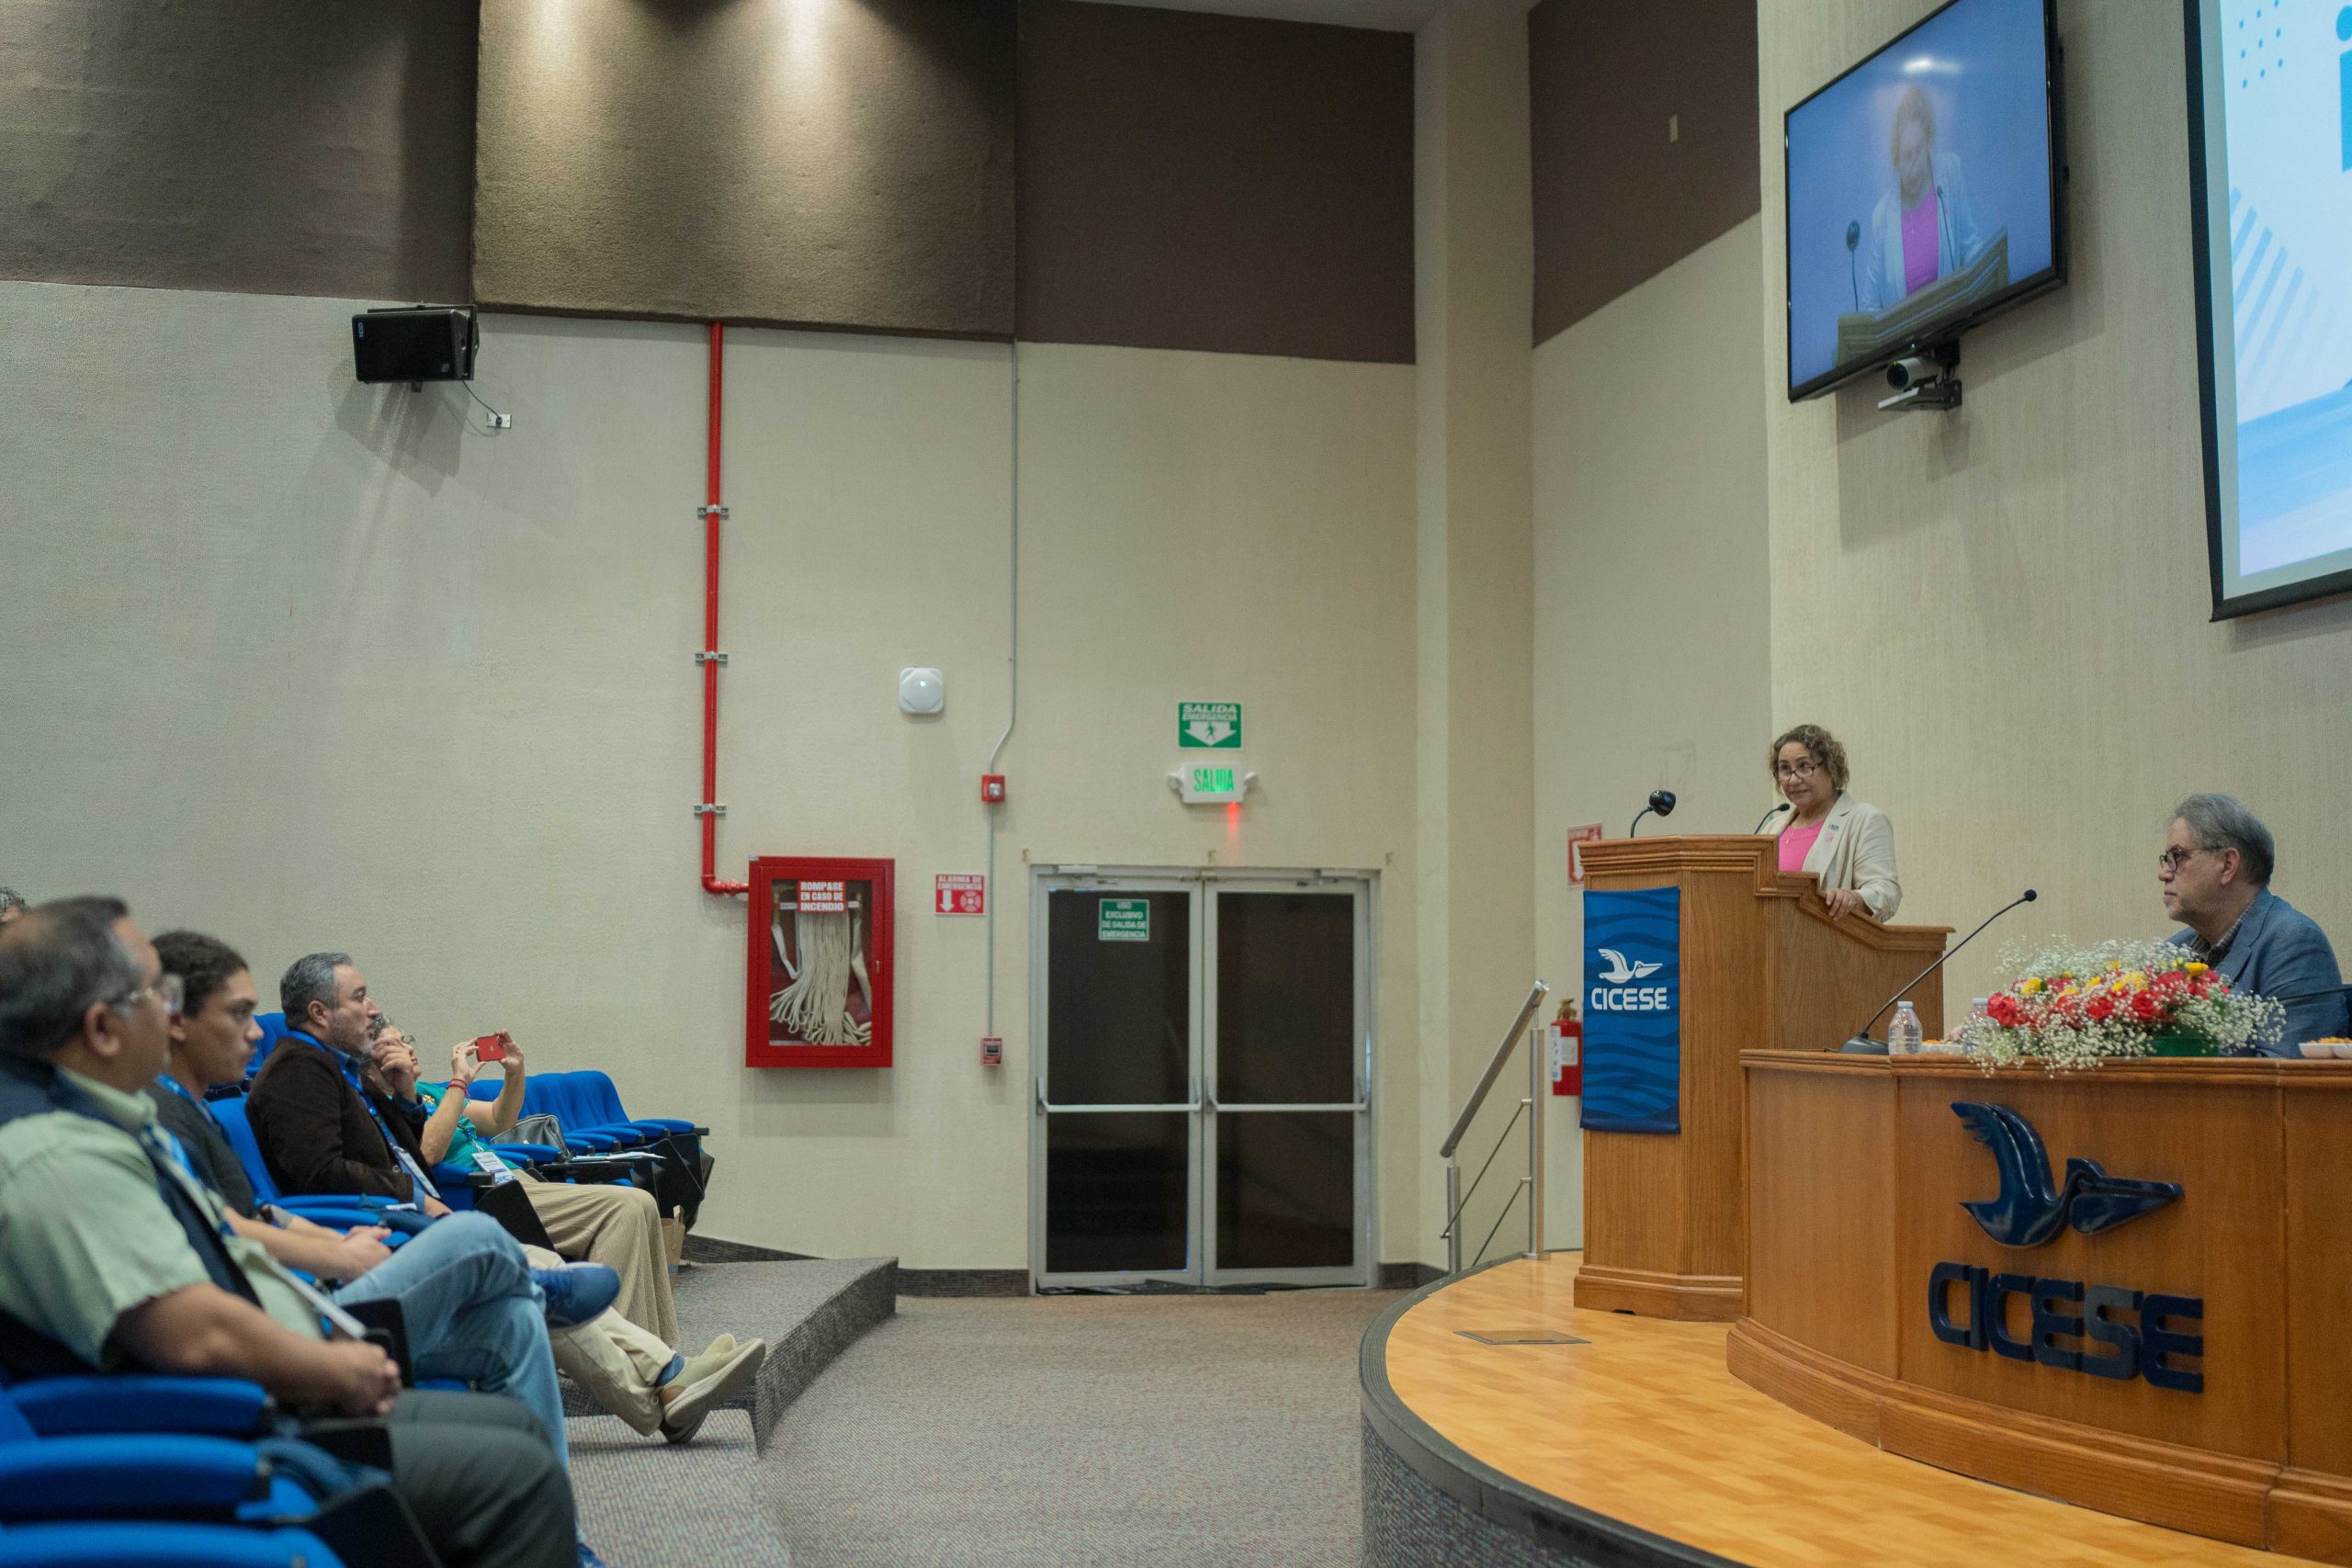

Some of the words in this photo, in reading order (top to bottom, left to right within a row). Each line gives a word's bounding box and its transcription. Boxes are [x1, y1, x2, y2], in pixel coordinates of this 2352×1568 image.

[1182, 705, 1237, 713] SALIDA
[1193, 769, 1235, 792] SALIDA
[937, 874, 971, 883] ALARMA
[800, 882, 843, 891] ROMPASE
[800, 892, 810, 900] EN
[811, 892, 832, 900] CASO
[833, 892, 843, 900] DE
[800, 902, 844, 911] INCENDIO
[1116, 901, 1132, 909] USO
[1105, 911, 1144, 919] EXCLUSIVO
[1112, 920, 1136, 929] SALIDA
[1136, 920, 1147, 929] DE
[1102, 930, 1146, 938] EMERGENCIA
[1591, 987, 1668, 1010] CICESE
[1928, 1261, 2204, 1395] CICESE
